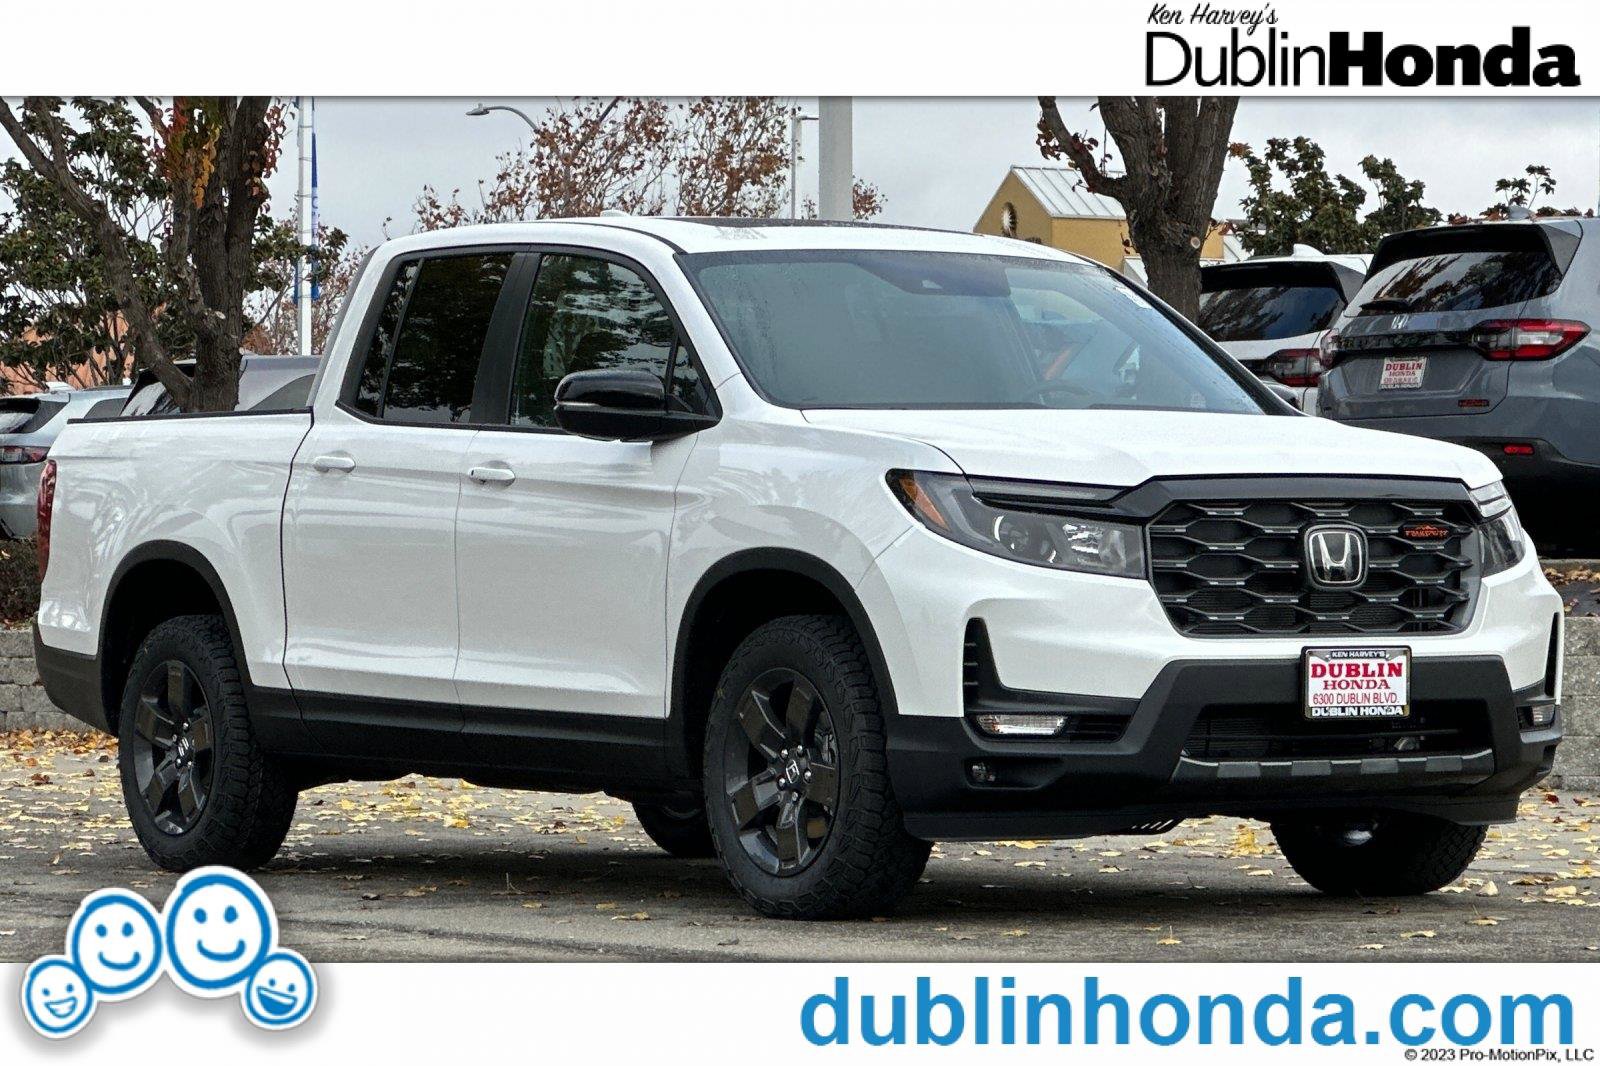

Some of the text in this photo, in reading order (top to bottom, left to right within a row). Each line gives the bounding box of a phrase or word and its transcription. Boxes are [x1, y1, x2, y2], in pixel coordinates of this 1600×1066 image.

[1385, 362, 1423, 371] DUBLIN
[1331, 650, 1349, 658] KEN
[1310, 662, 1403, 679] DUBLIN
[1322, 679, 1391, 690] HONDA
[1312, 693, 1335, 705] 6300
[1336, 692, 1371, 705] DUBLIN
[1311, 706, 1404, 717] DUBLIN HONDA
